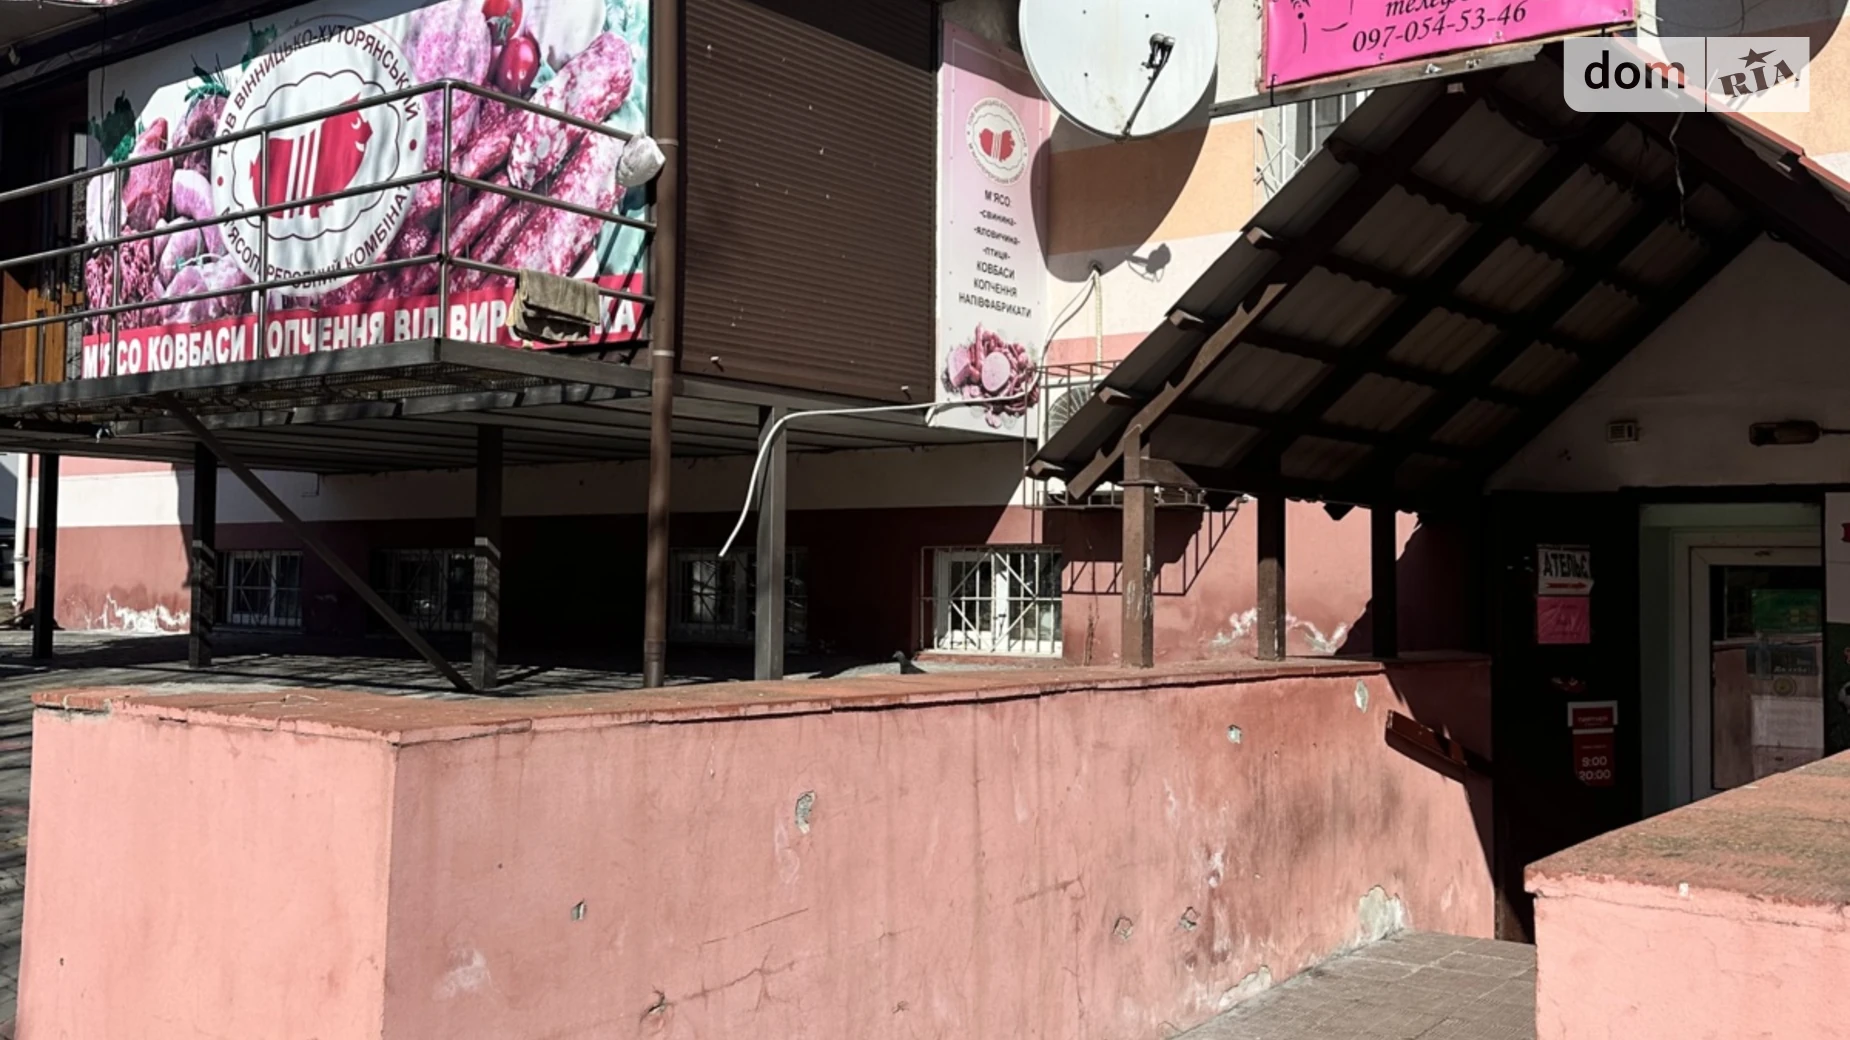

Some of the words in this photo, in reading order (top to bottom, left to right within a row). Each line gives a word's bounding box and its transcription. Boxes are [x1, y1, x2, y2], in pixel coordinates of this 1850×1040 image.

[1353, 1, 1526, 52] 097-054-53-46
[976, 260, 1015, 280] КОВБАСИ
[973, 277, 1018, 298] КОПЧЕННЯ
[958, 292, 1032, 319] НАПІВФАБРИКАТИ
[147, 325, 246, 373] КОВБАСИ
[252, 312, 386, 361] ОПЧЕННЯ
